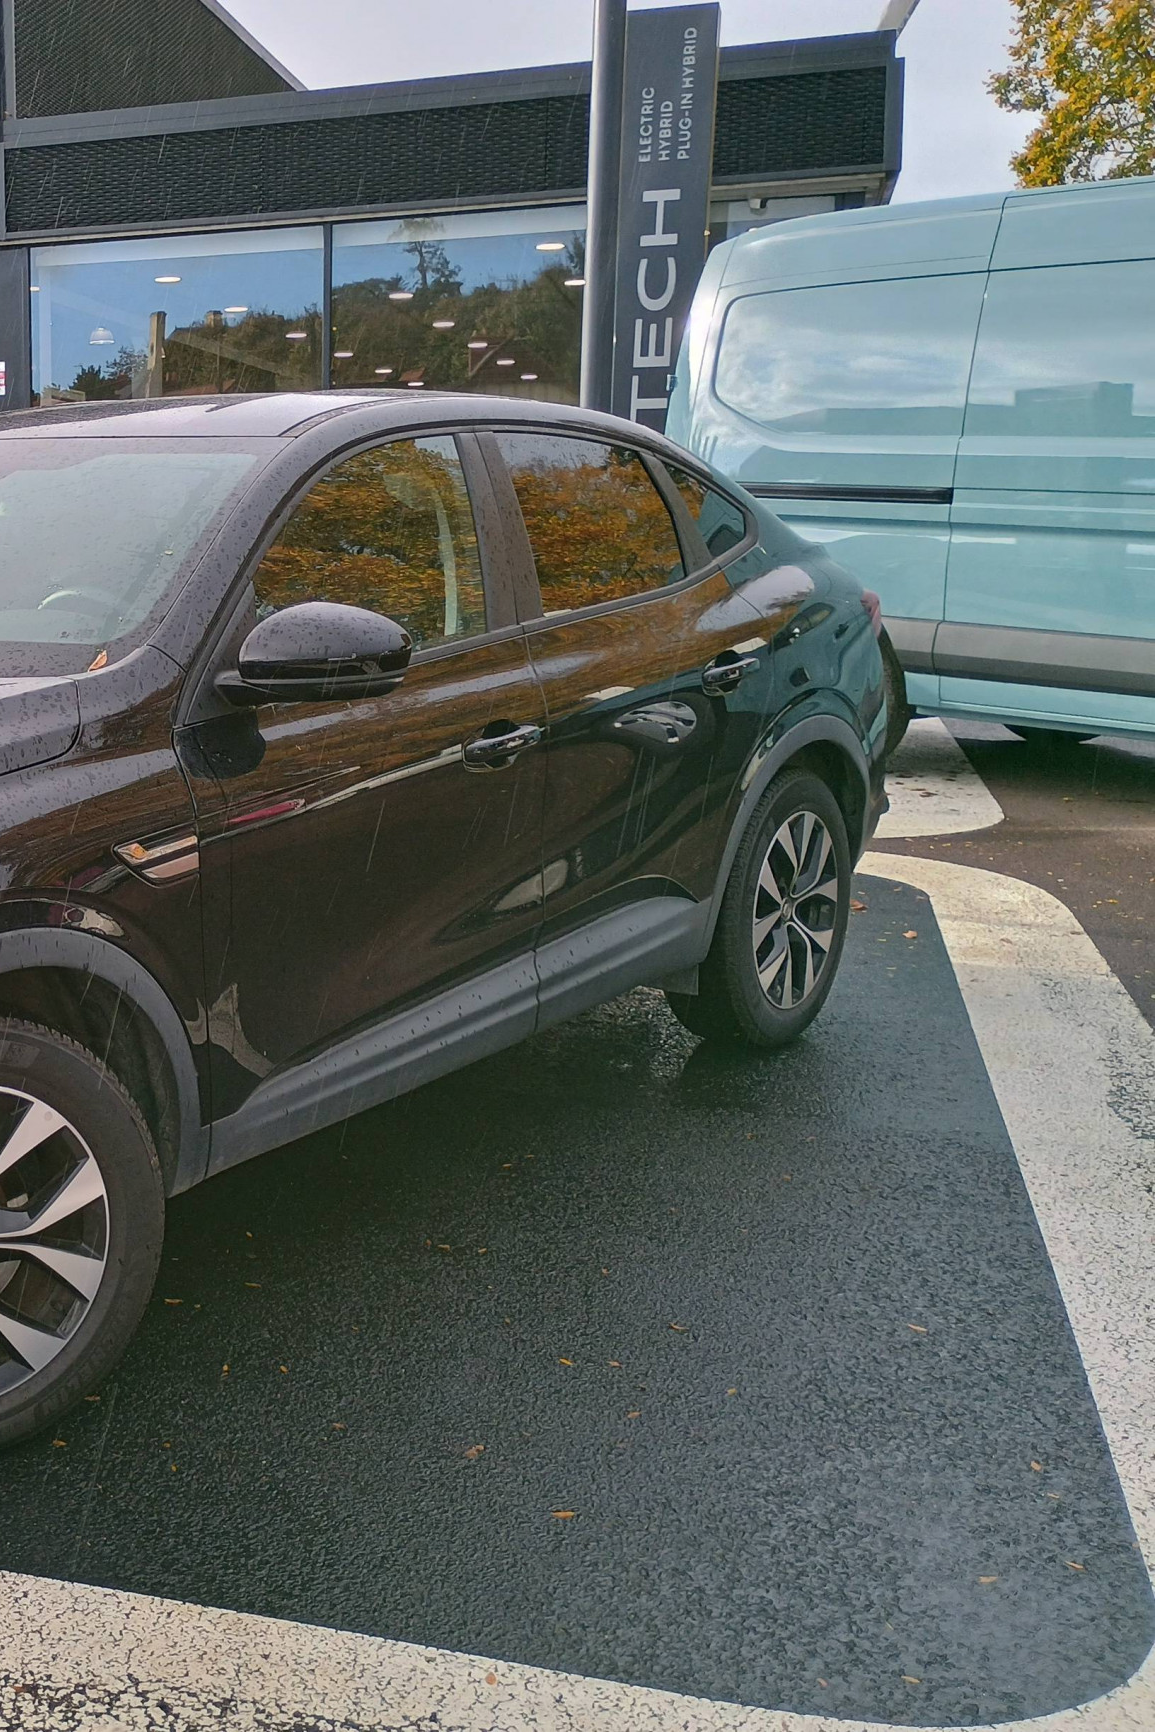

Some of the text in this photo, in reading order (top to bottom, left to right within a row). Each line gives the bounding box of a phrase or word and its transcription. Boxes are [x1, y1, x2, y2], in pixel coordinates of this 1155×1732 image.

[638, 87, 655, 162] ELECTRIC
[658, 101, 673, 161] HYBRID
[677, 27, 697, 160] PLUG-IN HYBRID
